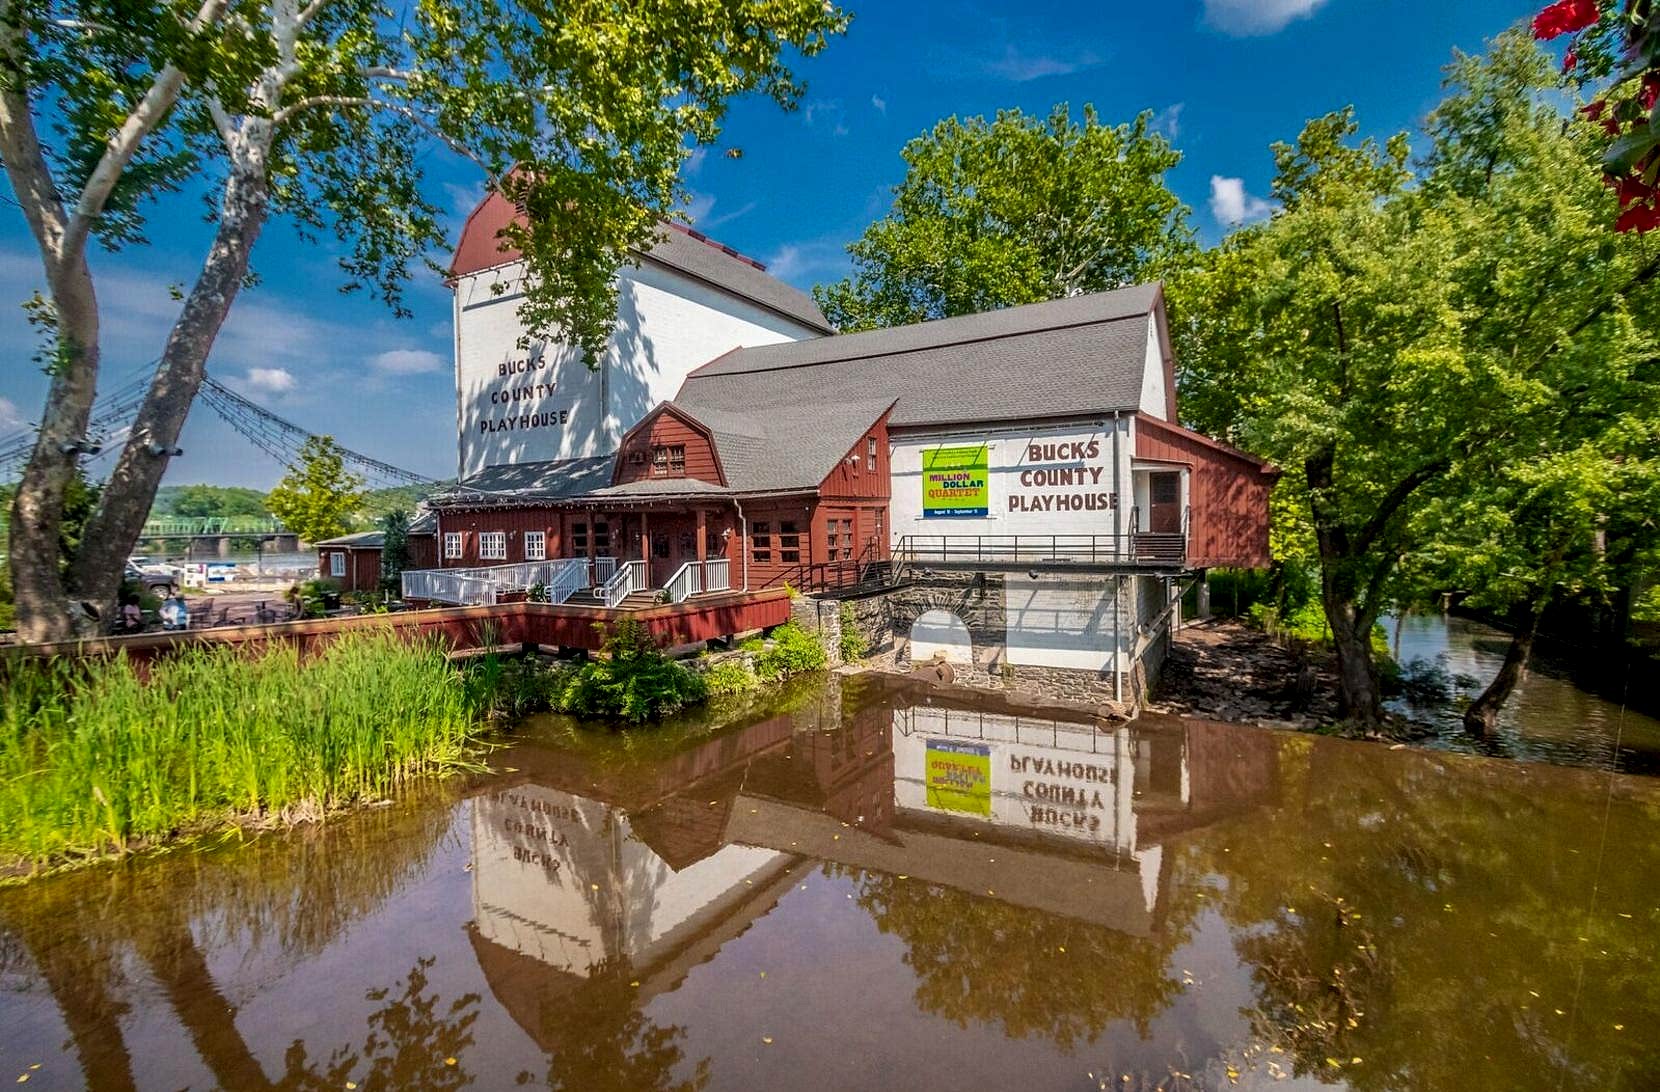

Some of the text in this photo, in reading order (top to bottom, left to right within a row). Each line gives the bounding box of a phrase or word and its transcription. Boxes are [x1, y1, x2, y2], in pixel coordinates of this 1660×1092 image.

[499, 356, 546, 376] BUCKS
[491, 383, 556, 404] COUNTY
[480, 410, 568, 433] PLAYHOUSE
[1028, 441, 1099, 461] BUCKS
[929, 473, 970, 482] MILLION
[943, 480, 984, 488] DOLLAR
[1020, 467, 1104, 487] COUNTY
[928, 488, 980, 498] QUARTET
[1008, 493, 1118, 512] PLAYHOUSE
